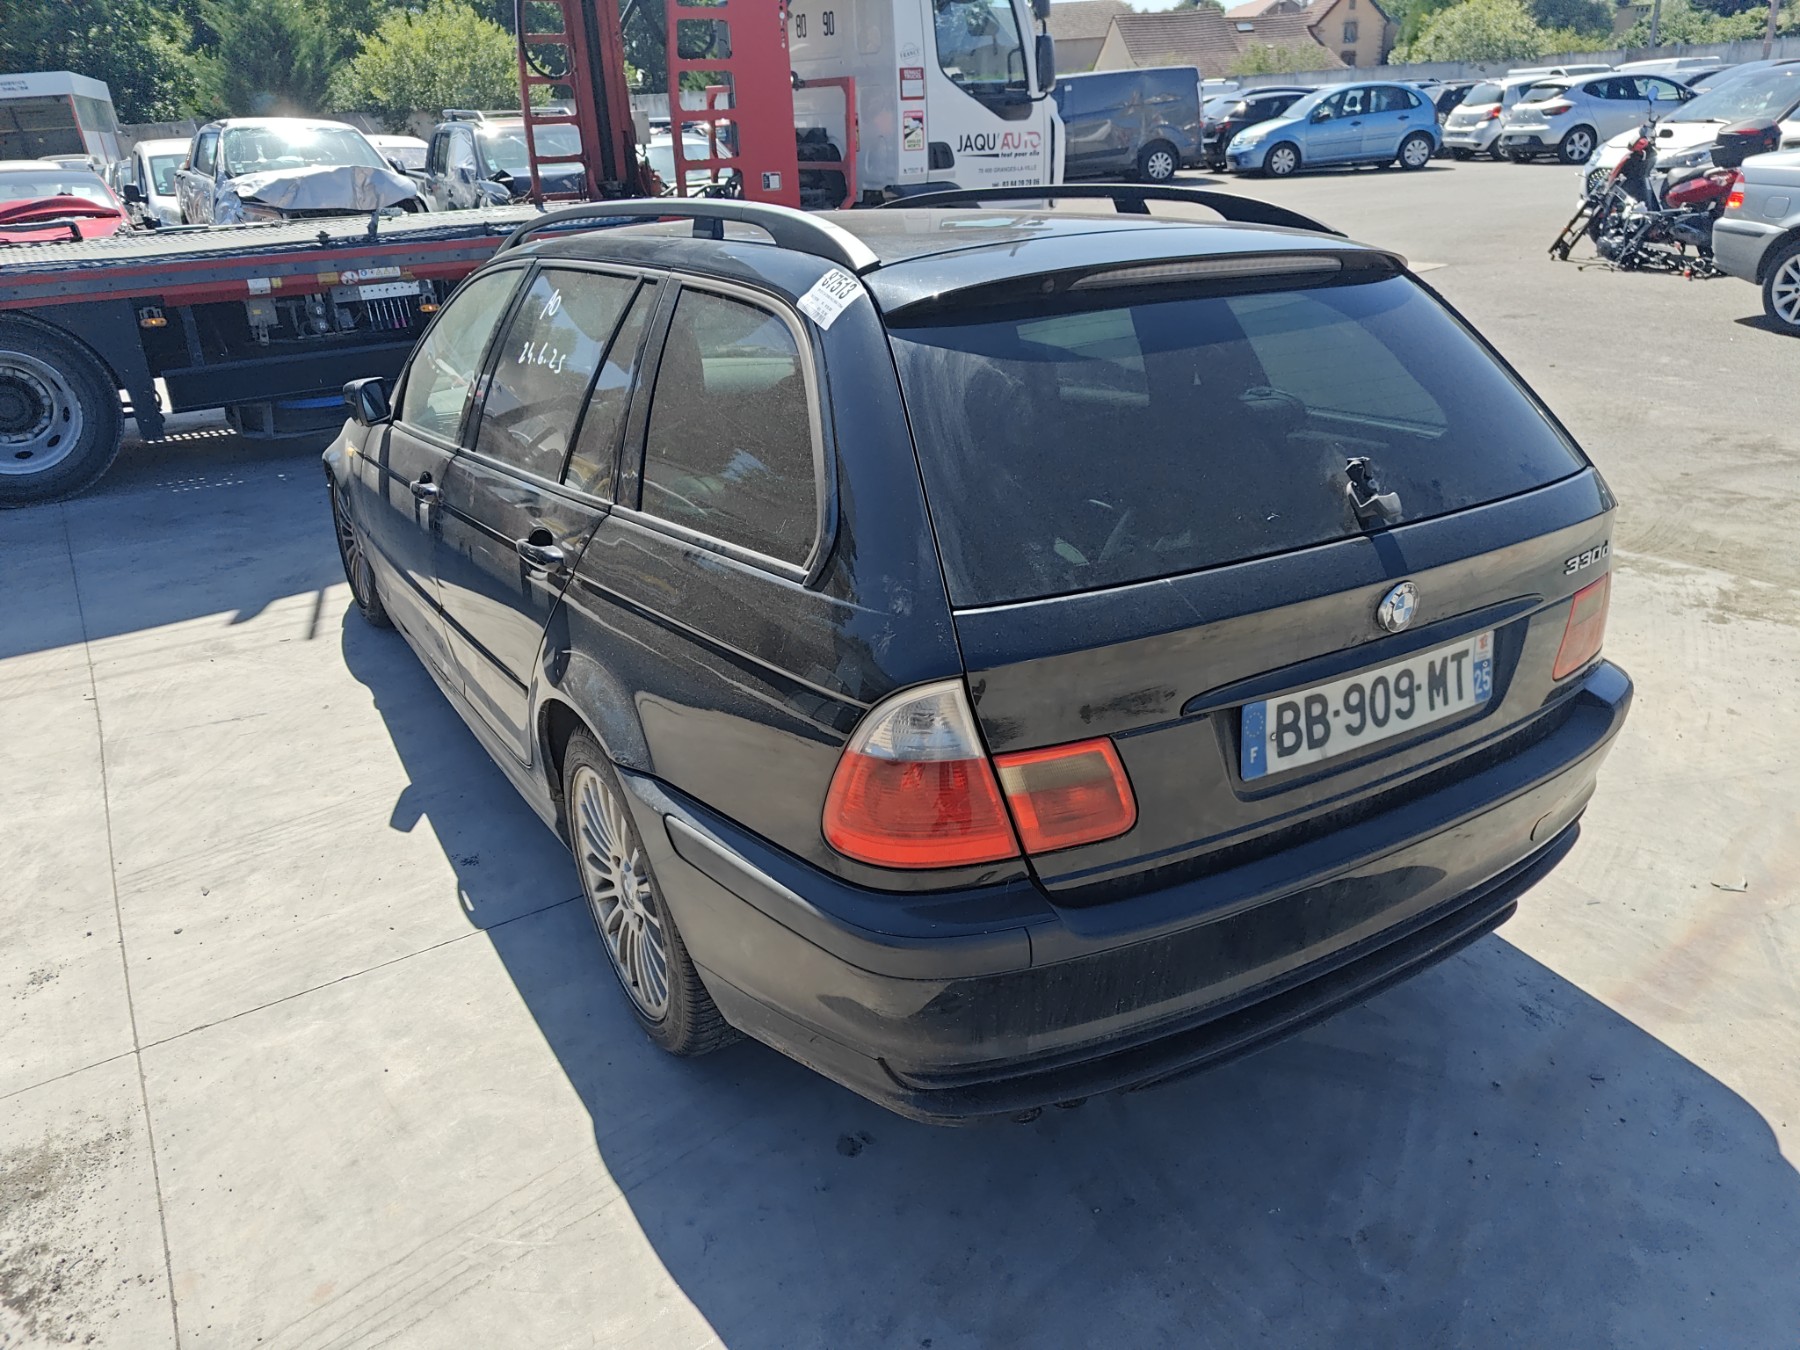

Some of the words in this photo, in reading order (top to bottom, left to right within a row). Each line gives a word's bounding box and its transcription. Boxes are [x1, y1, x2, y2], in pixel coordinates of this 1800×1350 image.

[795, 13, 807, 38] 80
[823, 11, 835, 36] 90
[1563, 540, 1609, 576] 330d
[1475, 667, 1491, 695] 25
[1275, 649, 1470, 758] BB-909-MT
[1250, 746, 1259, 764] F
